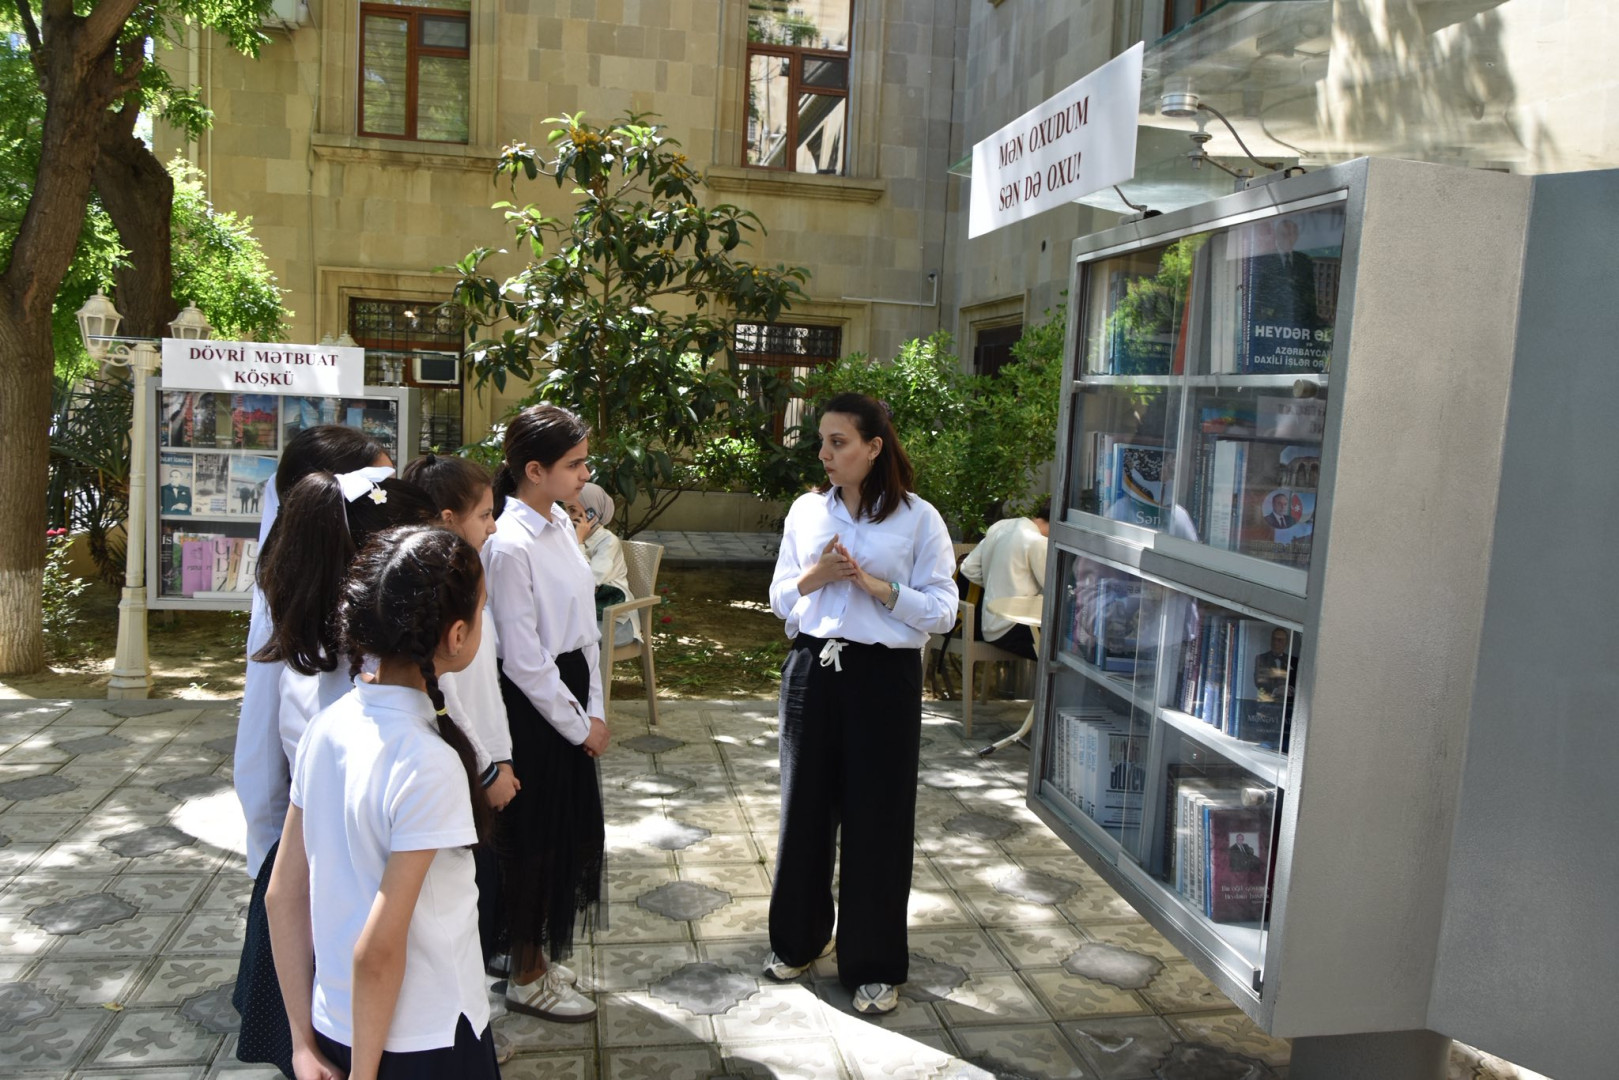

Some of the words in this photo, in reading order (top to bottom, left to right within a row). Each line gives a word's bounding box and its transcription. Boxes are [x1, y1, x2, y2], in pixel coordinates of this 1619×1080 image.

[998, 133, 1024, 170] MƏN
[1029, 95, 1090, 153] OXUDUM
[998, 180, 1021, 212] SƏN
[1024, 170, 1042, 202] DƏ
[1047, 151, 1082, 192] OXU!
[1254, 325, 1311, 341] HEYDƏR
[189, 344, 246, 362] DÖVRİ
[254, 350, 339, 367] MƏTBUAT
[1254, 354, 1283, 366] DAXİLİ
[234, 368, 295, 387] KÖŞKÜ
[1135, 510, 1161, 525] Sən
